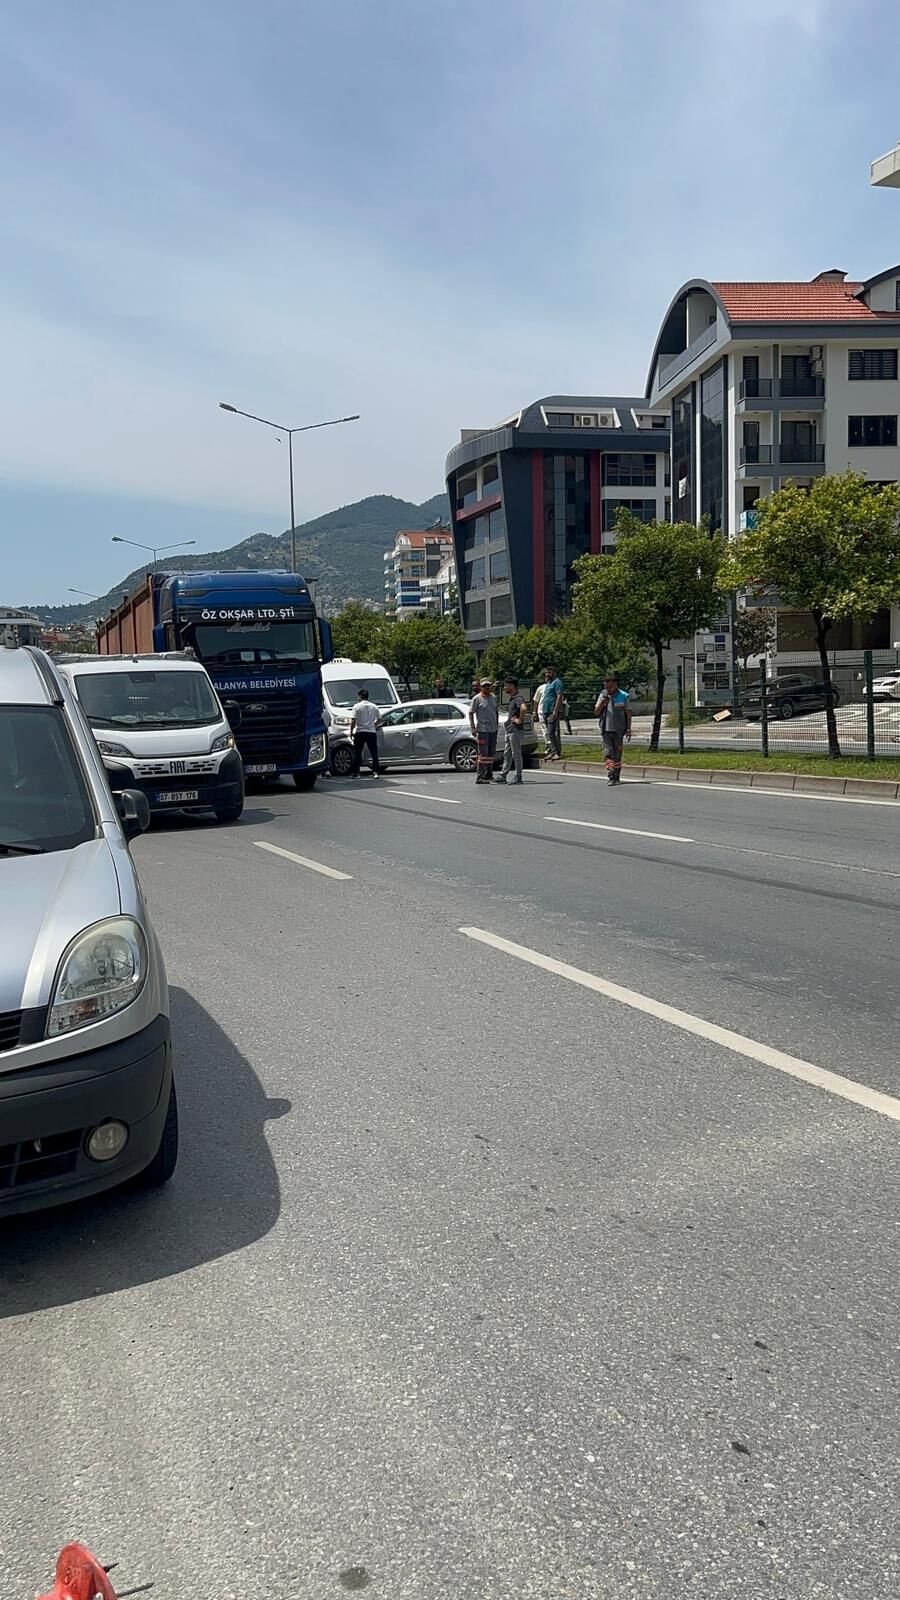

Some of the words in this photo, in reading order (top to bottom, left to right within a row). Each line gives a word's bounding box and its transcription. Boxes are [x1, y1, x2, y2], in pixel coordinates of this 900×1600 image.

[201, 608, 217, 620] ÖZ
[219, 609, 255, 621] OKŞAR
[257, 608, 279, 618] LTD.
[279, 606, 295, 620] ŞTİ
[213, 681, 248, 690] ALANYA
[250, 677, 296, 689] BELEDİYESİ
[169, 760, 186, 774] FIAT
